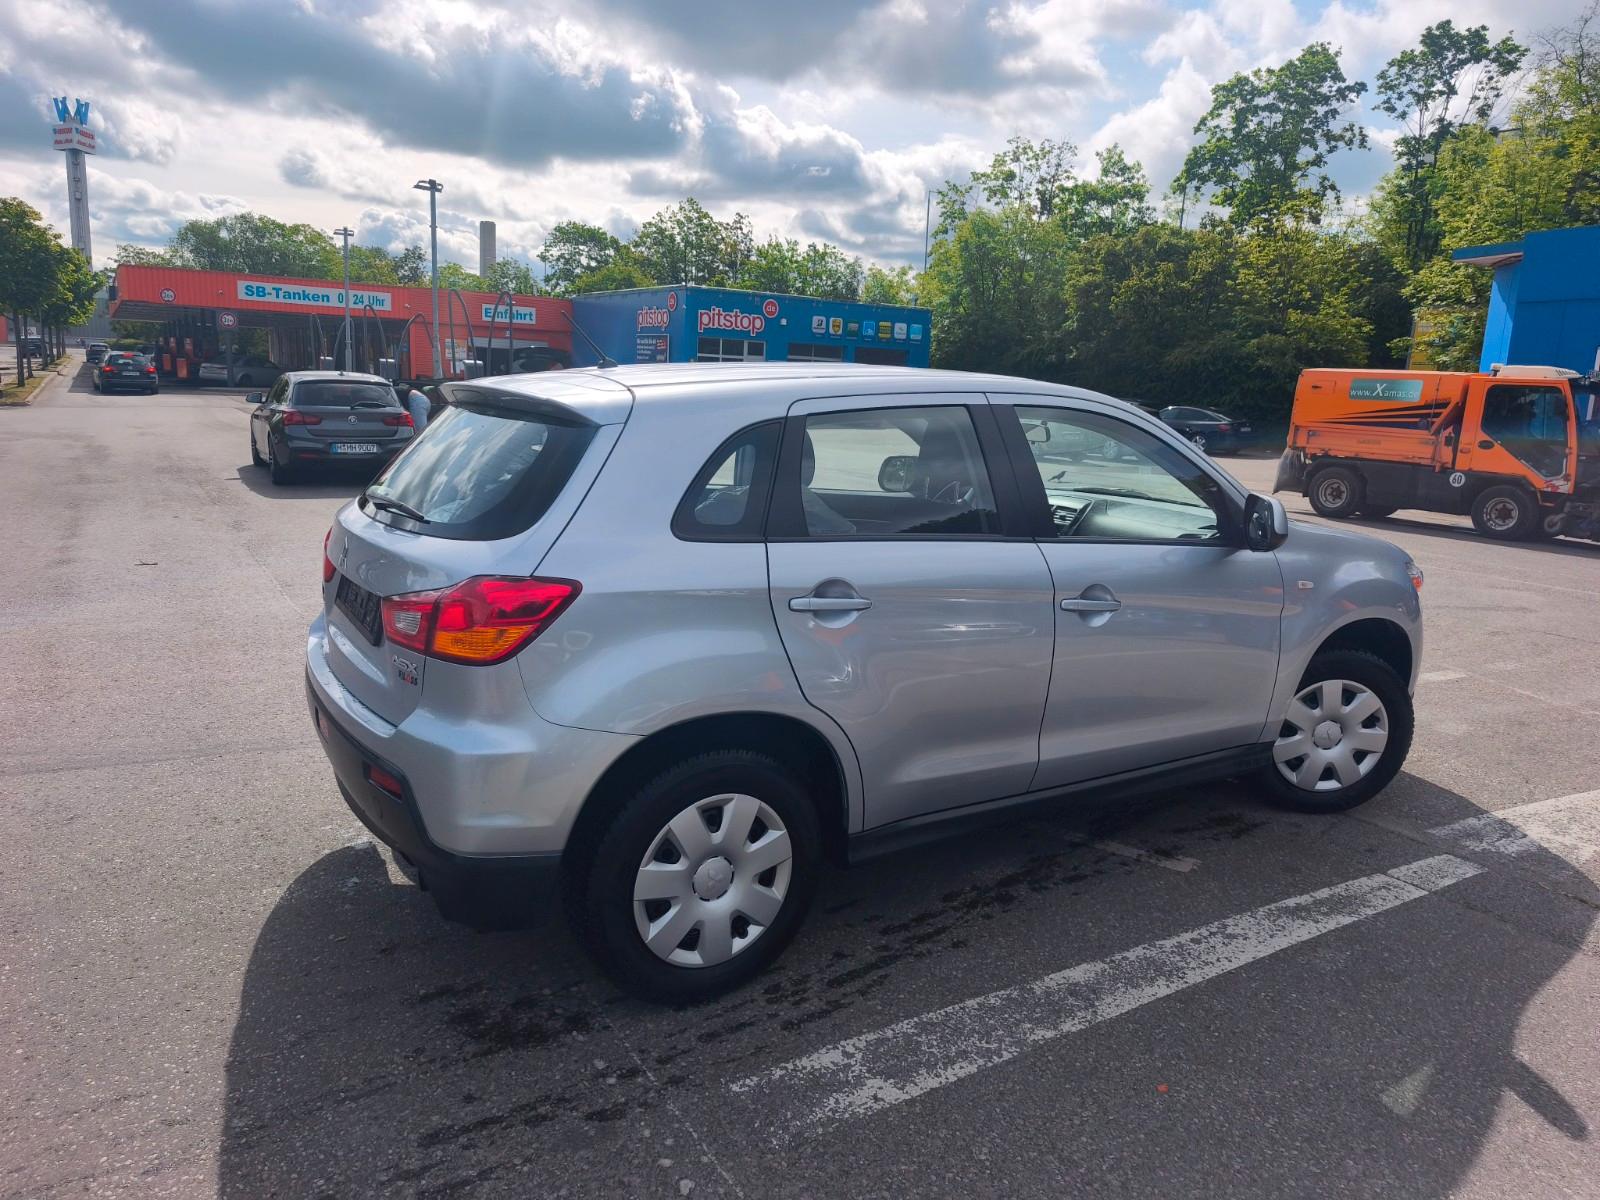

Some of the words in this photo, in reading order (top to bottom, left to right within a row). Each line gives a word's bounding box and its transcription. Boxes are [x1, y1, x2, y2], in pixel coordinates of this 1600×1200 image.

[244, 284, 330, 303] SB-Tanken
[368, 295, 386, 307] Uhr
[484, 307, 534, 321] Enfahrt
[637, 306, 669, 331] pitstop
[698, 306, 765, 336] pitstop
[1451, 473, 1463, 486] 60
[392, 655, 418, 676] ASX
